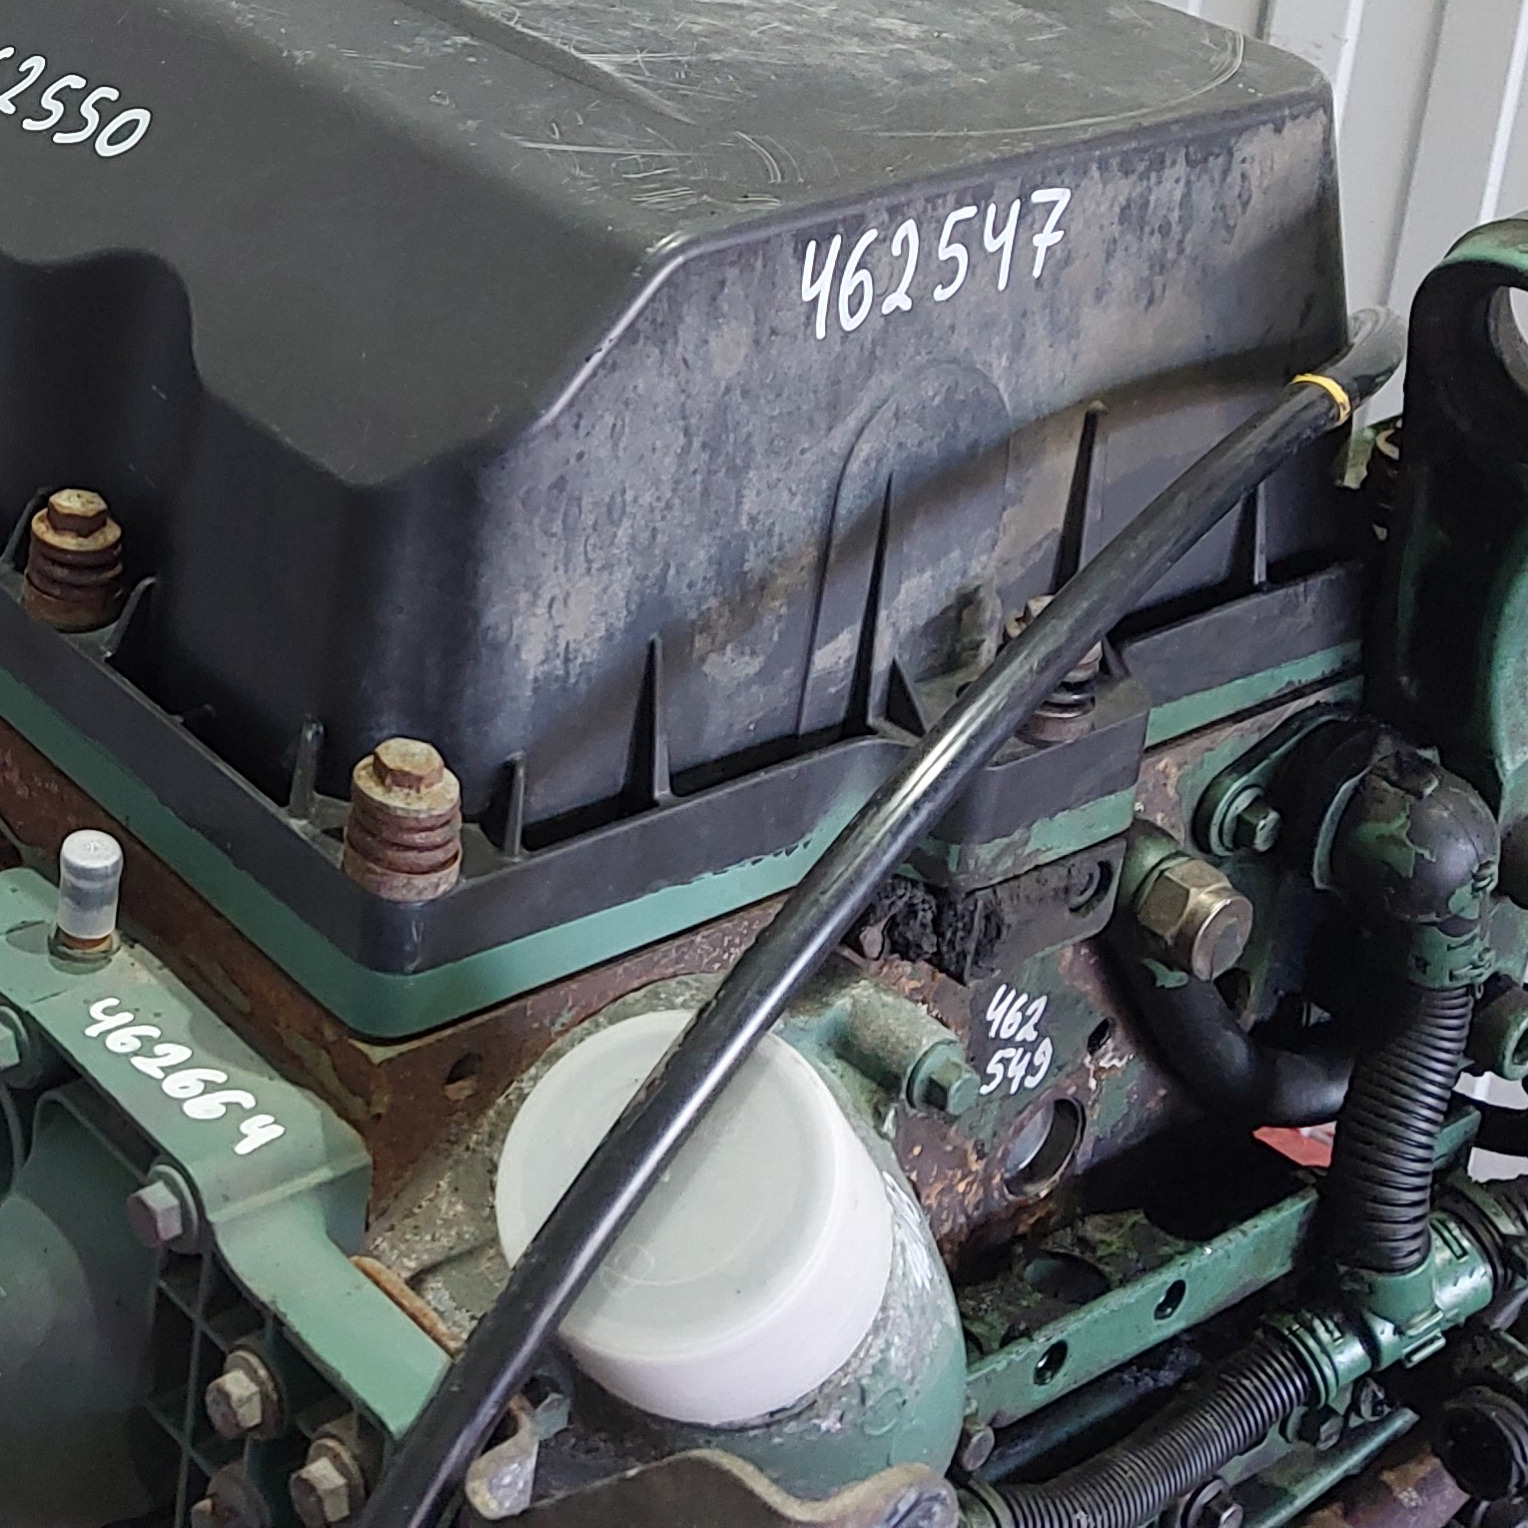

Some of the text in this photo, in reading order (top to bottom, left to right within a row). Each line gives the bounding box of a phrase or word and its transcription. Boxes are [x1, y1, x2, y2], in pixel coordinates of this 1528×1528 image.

[800, 187, 1072, 340] 462547
[986, 983, 1048, 1042] 462
[84, 997, 286, 1155] 462664
[979, 1037, 1053, 1096] 549
